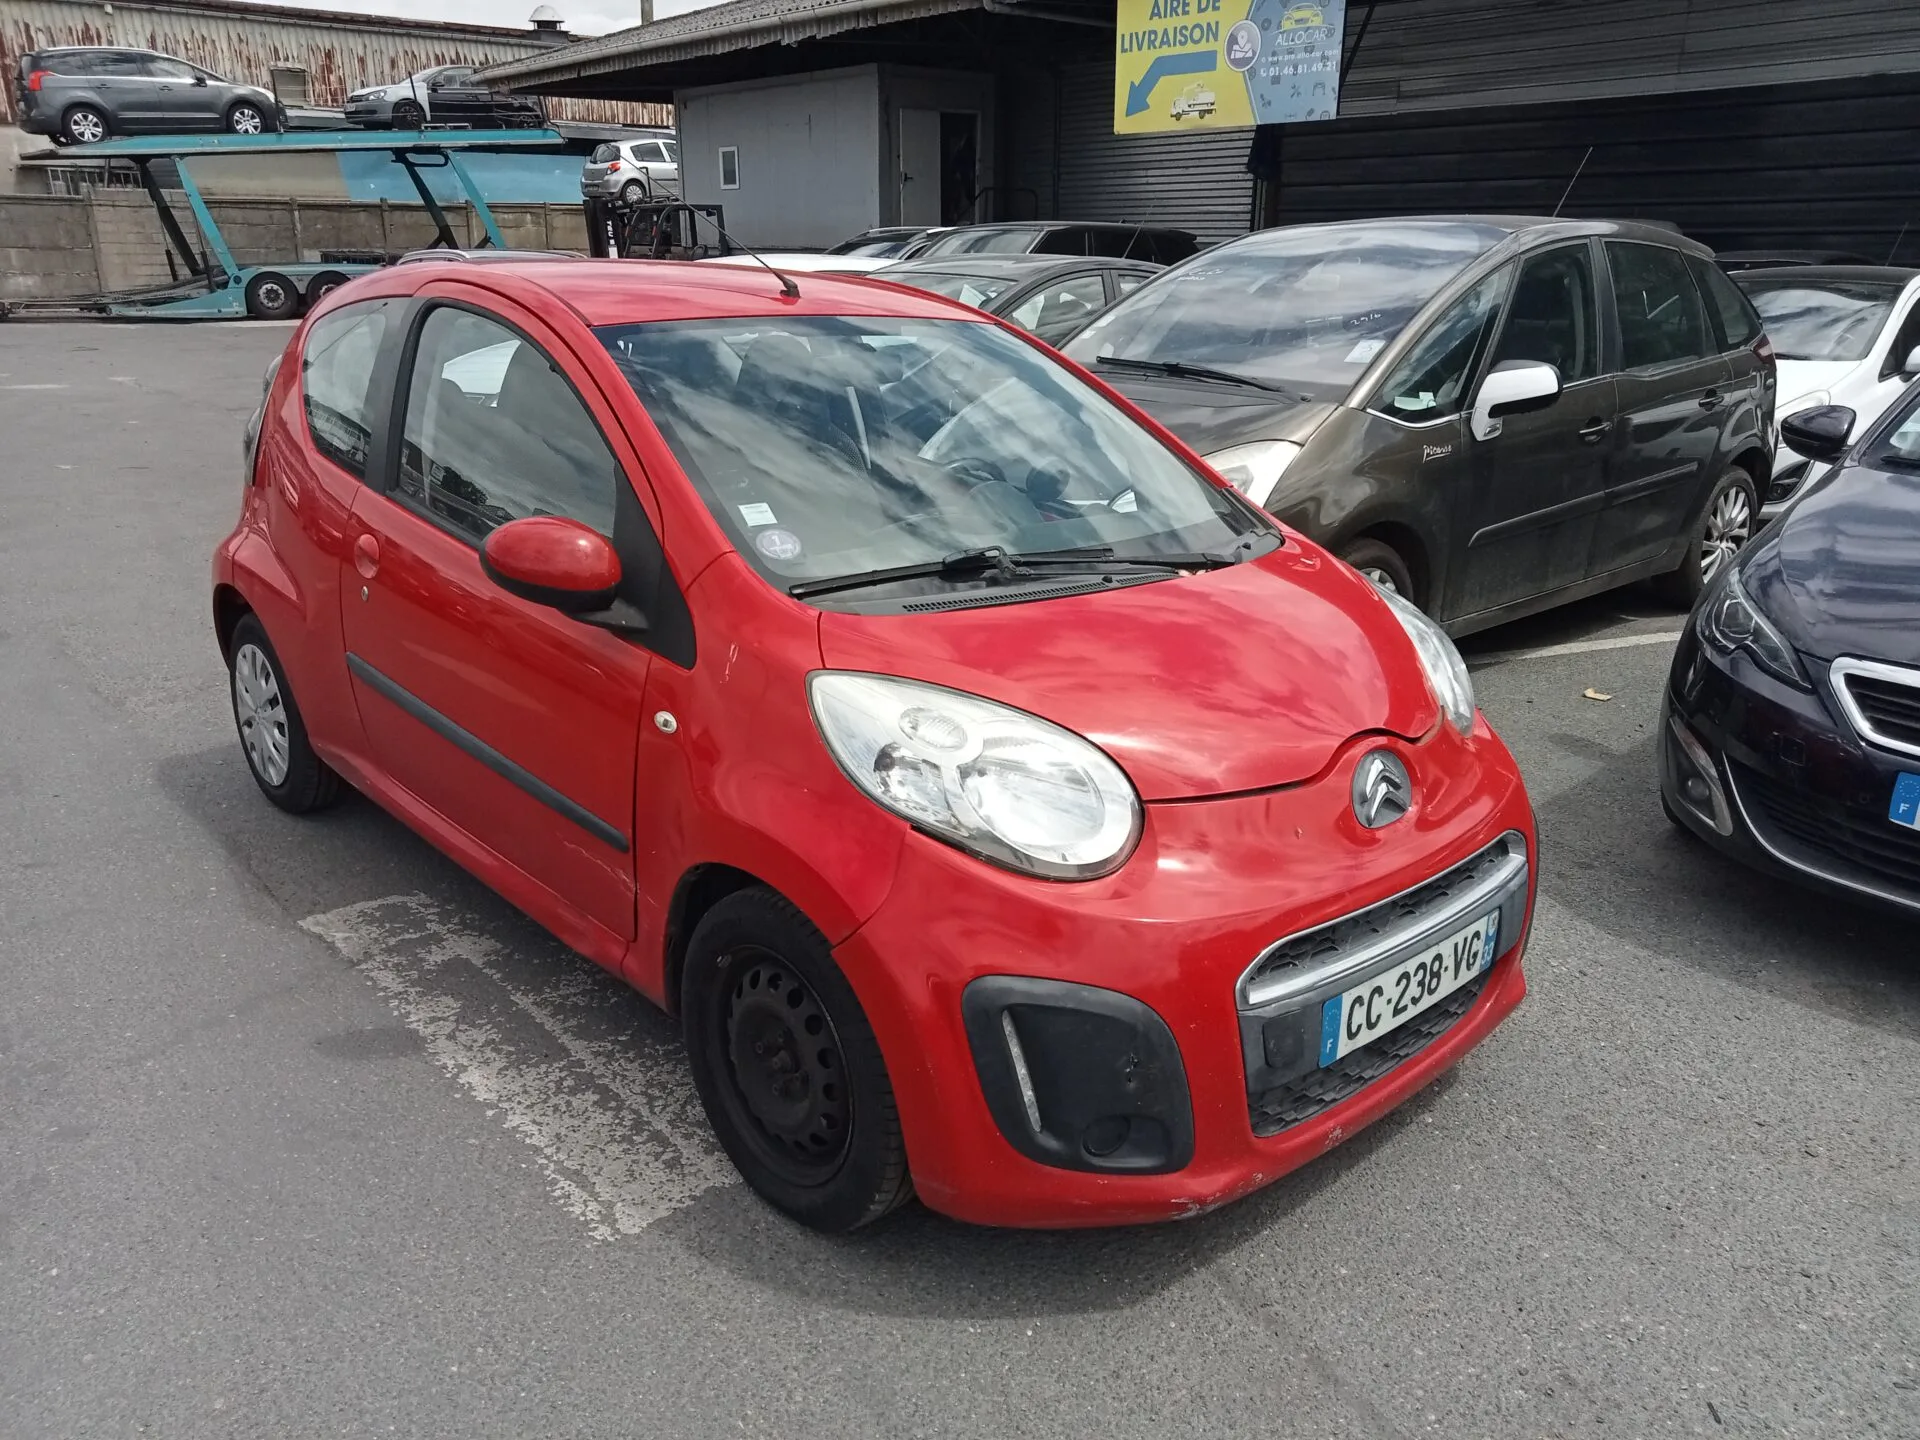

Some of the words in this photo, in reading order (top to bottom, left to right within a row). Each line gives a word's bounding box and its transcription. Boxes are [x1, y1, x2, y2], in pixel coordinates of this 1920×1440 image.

[1149, 0, 1190, 20] AIRE
[1197, 0, 1221, 14] DE
[1120, 21, 1219, 53] LIVRAISON
[1275, 28, 1328, 46] ALLOCAR
[1899, 803, 1910, 813] F
[1346, 930, 1482, 1041] CC-238-VG
[1326, 1039, 1334, 1053] F
